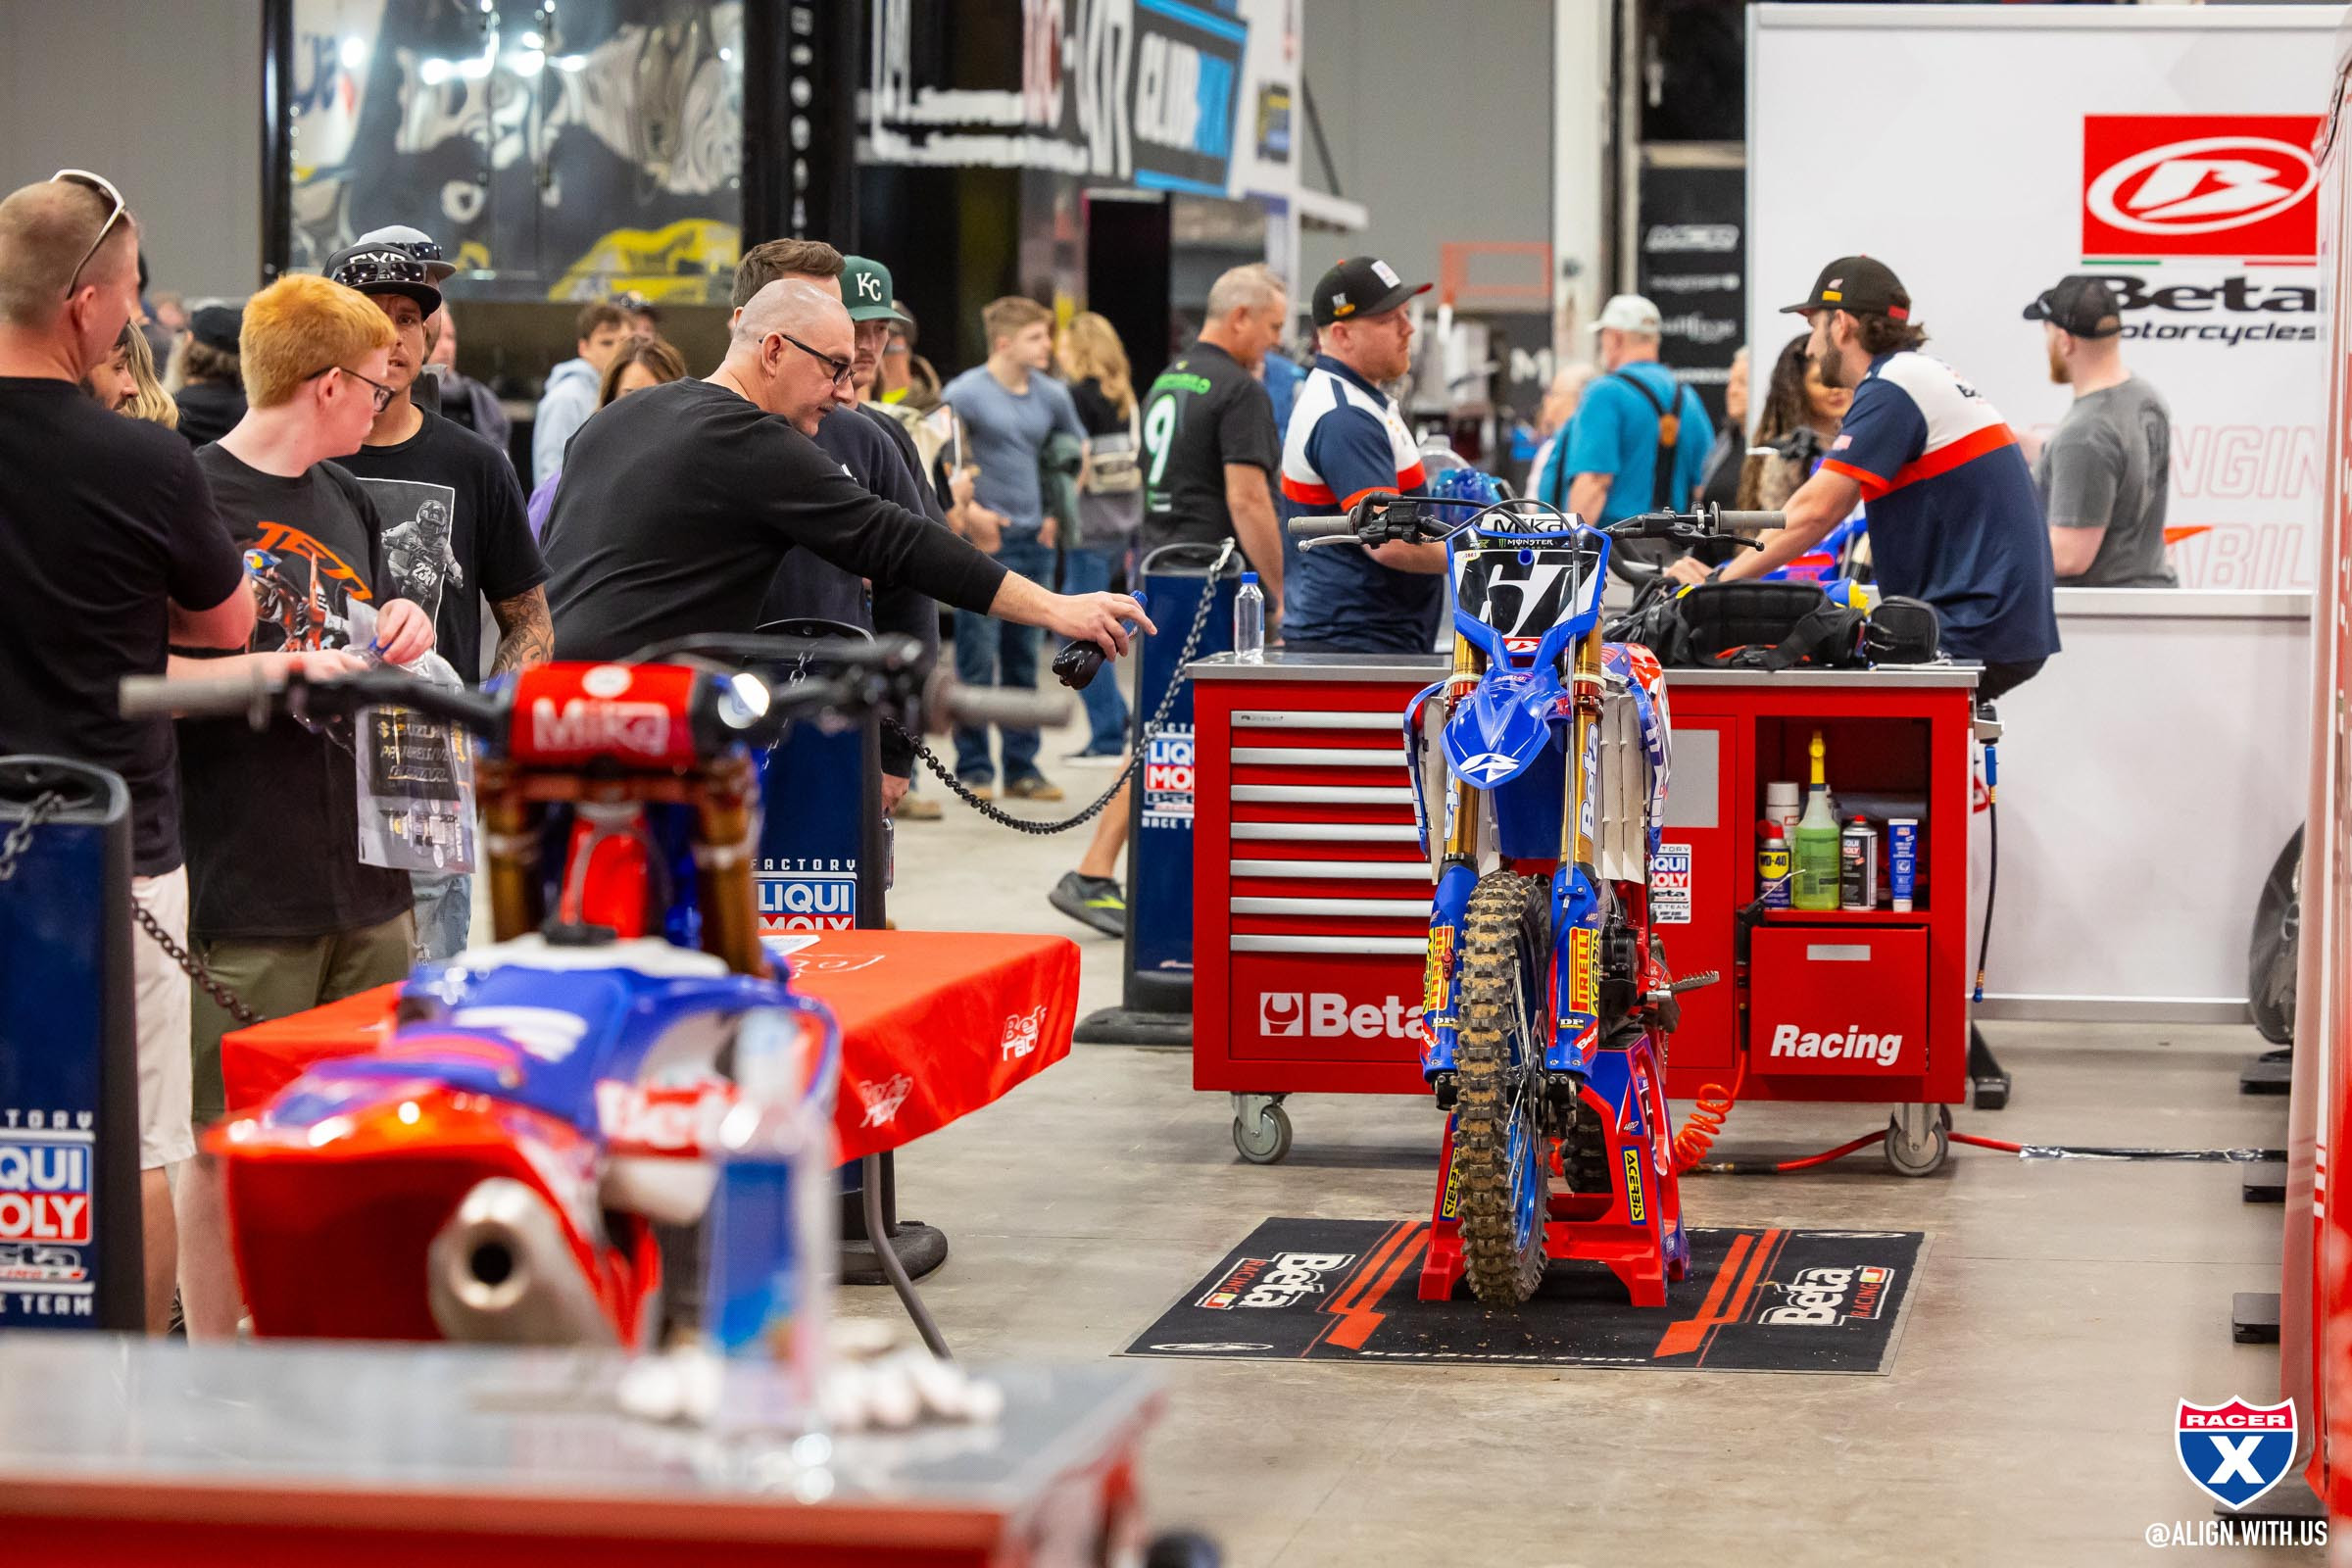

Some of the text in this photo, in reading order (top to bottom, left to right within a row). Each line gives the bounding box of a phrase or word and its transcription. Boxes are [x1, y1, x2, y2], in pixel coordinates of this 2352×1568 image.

[856, 271, 882, 302] KC
[2117, 321, 2316, 346] otorcycles
[1144, 394, 1176, 485] 9
[1150, 742, 1195, 765] LIQ
[1150, 767, 1195, 790] MO
[1580, 723, 1599, 840] Beta
[1650, 858, 1687, 871] IQUI
[758, 884, 850, 913] LIQUI
[1570, 929, 1589, 1010] PIRELLI
[1309, 993, 1423, 1039] Beta
[1770, 1024, 1903, 1066] Racing
[6, 1109, 93, 1128] TORY
[0, 1147, 82, 1192] QUI
[0, 1194, 86, 1238] OLY
[1219, 1258, 1266, 1293] RACING
[1239, 1253, 1349, 1306] Beta
[1768, 1268, 1854, 1324] Beta
[1850, 1283, 1881, 1318] RACING
